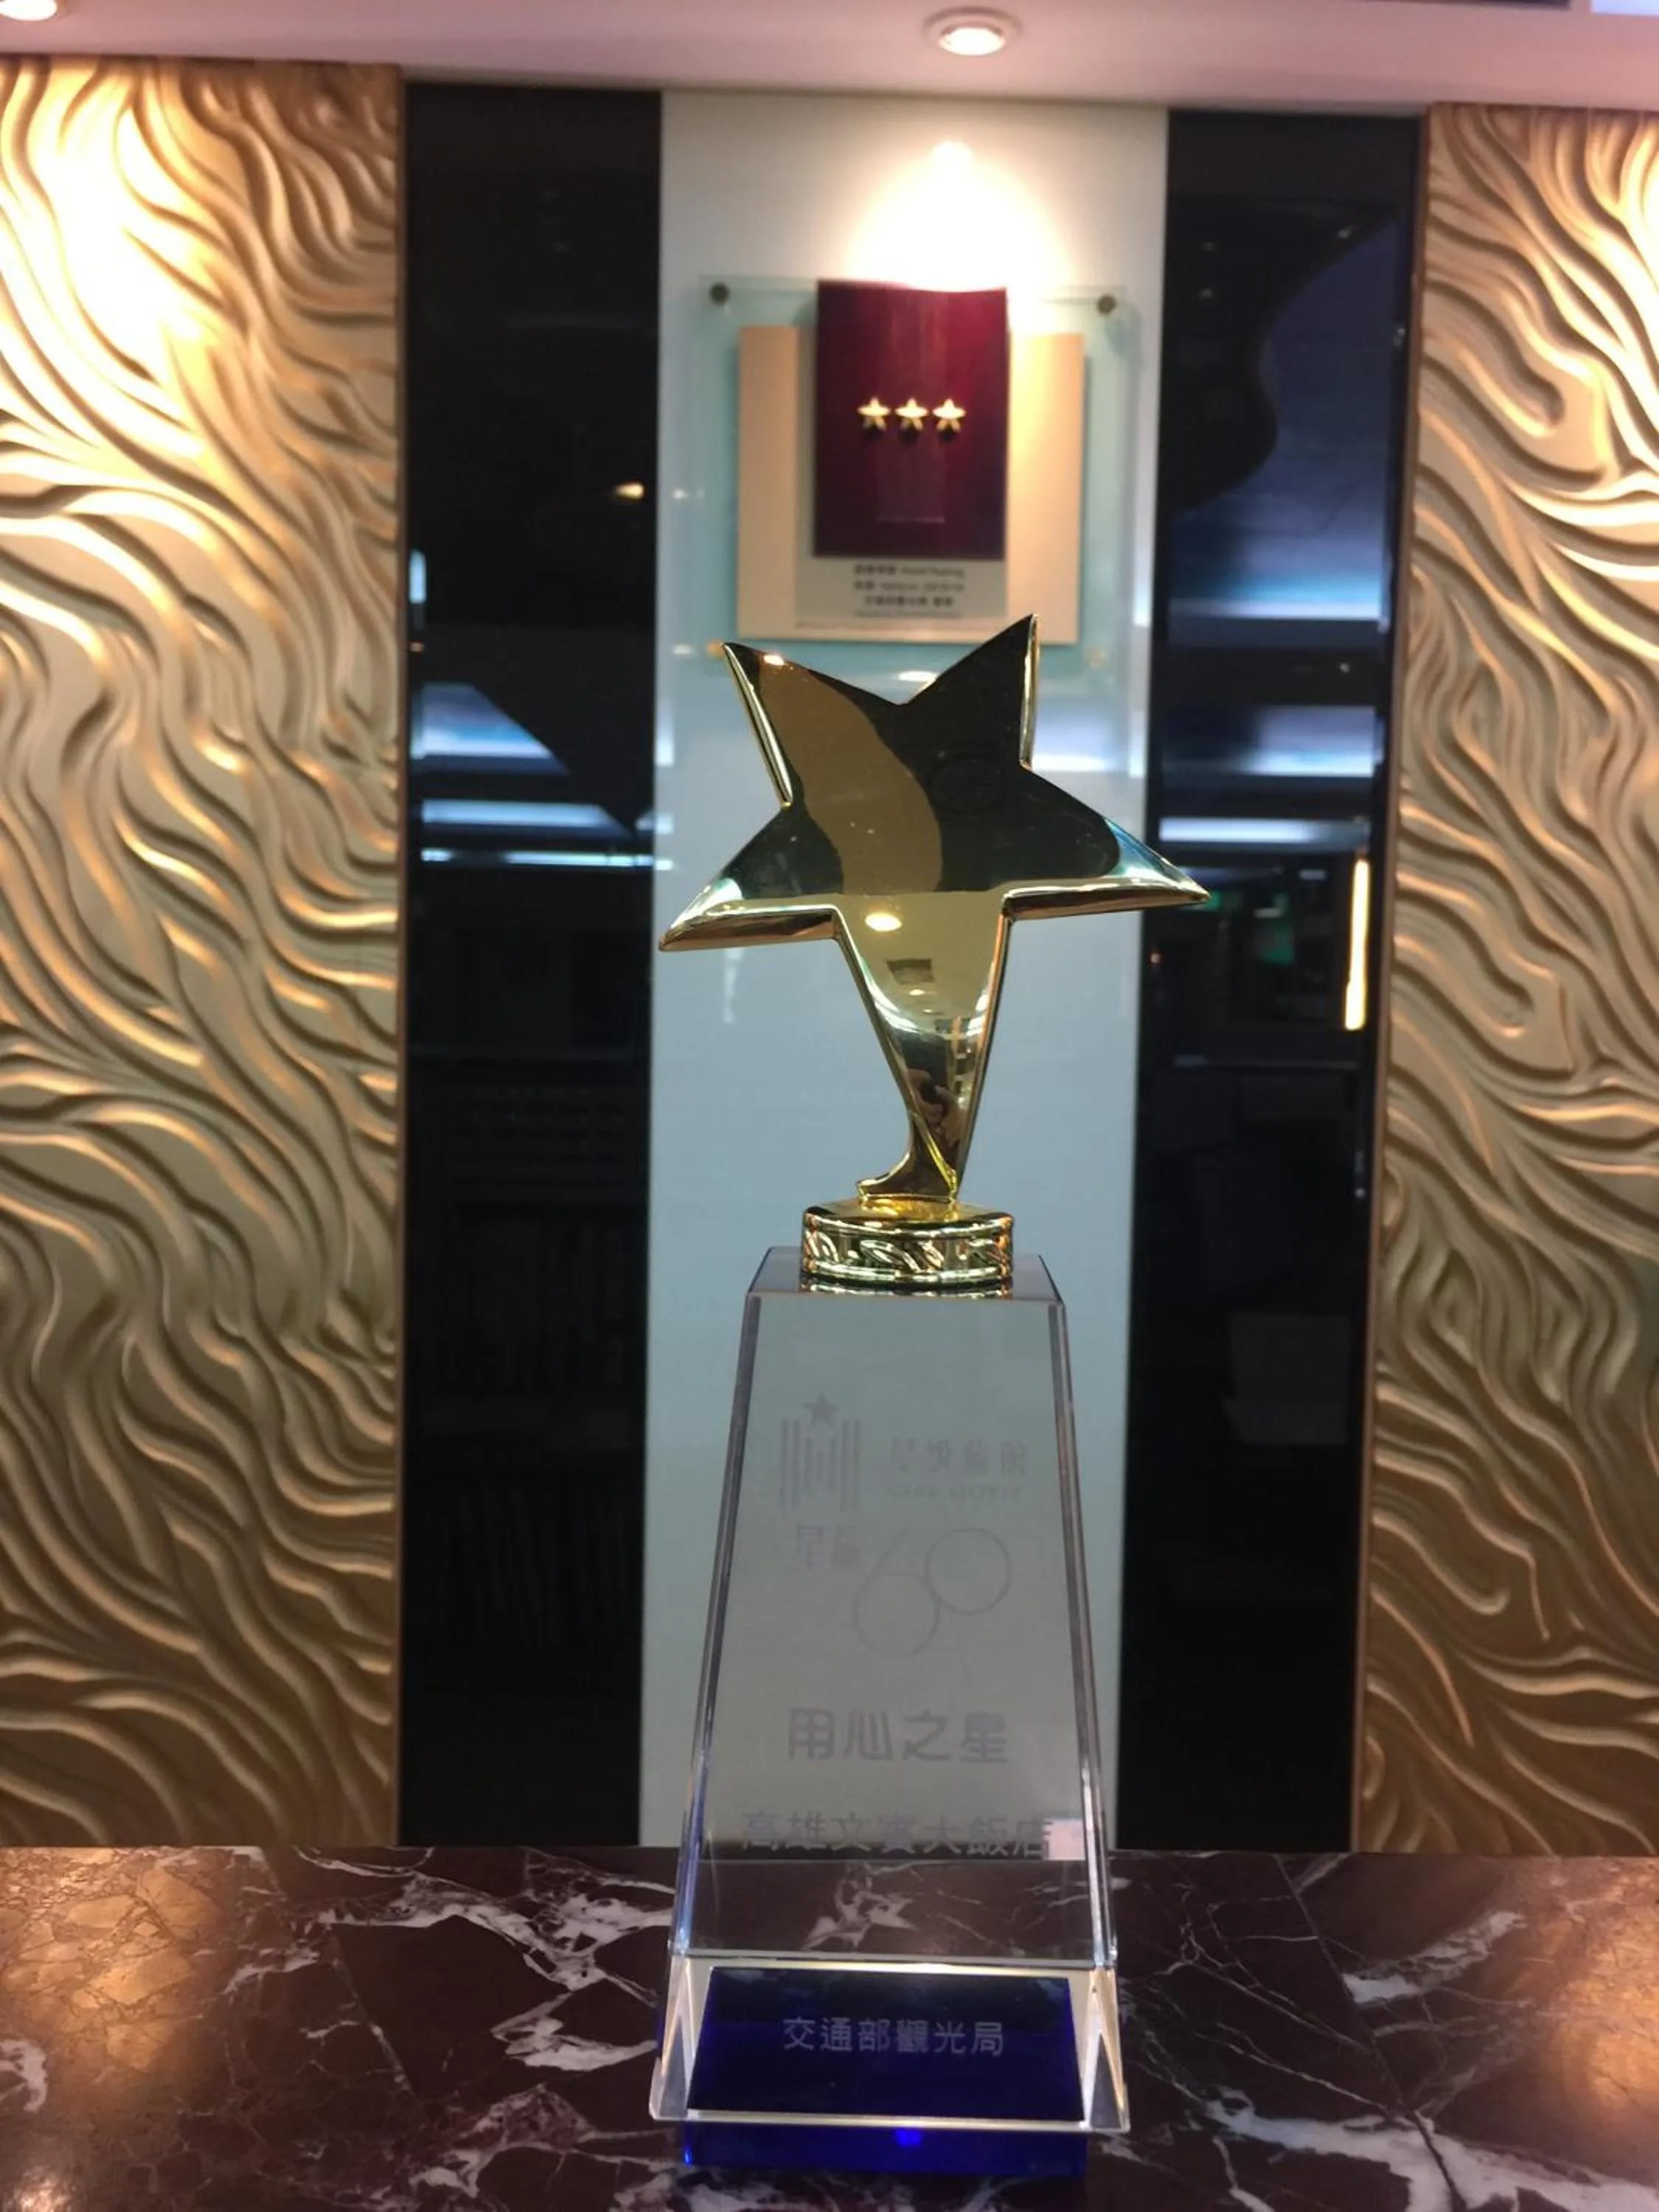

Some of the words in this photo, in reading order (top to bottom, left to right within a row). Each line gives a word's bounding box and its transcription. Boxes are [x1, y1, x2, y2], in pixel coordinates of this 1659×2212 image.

[787, 1707, 1007, 1763] 用心之星
[783, 2017, 1004, 2056] 交通部觀光局
